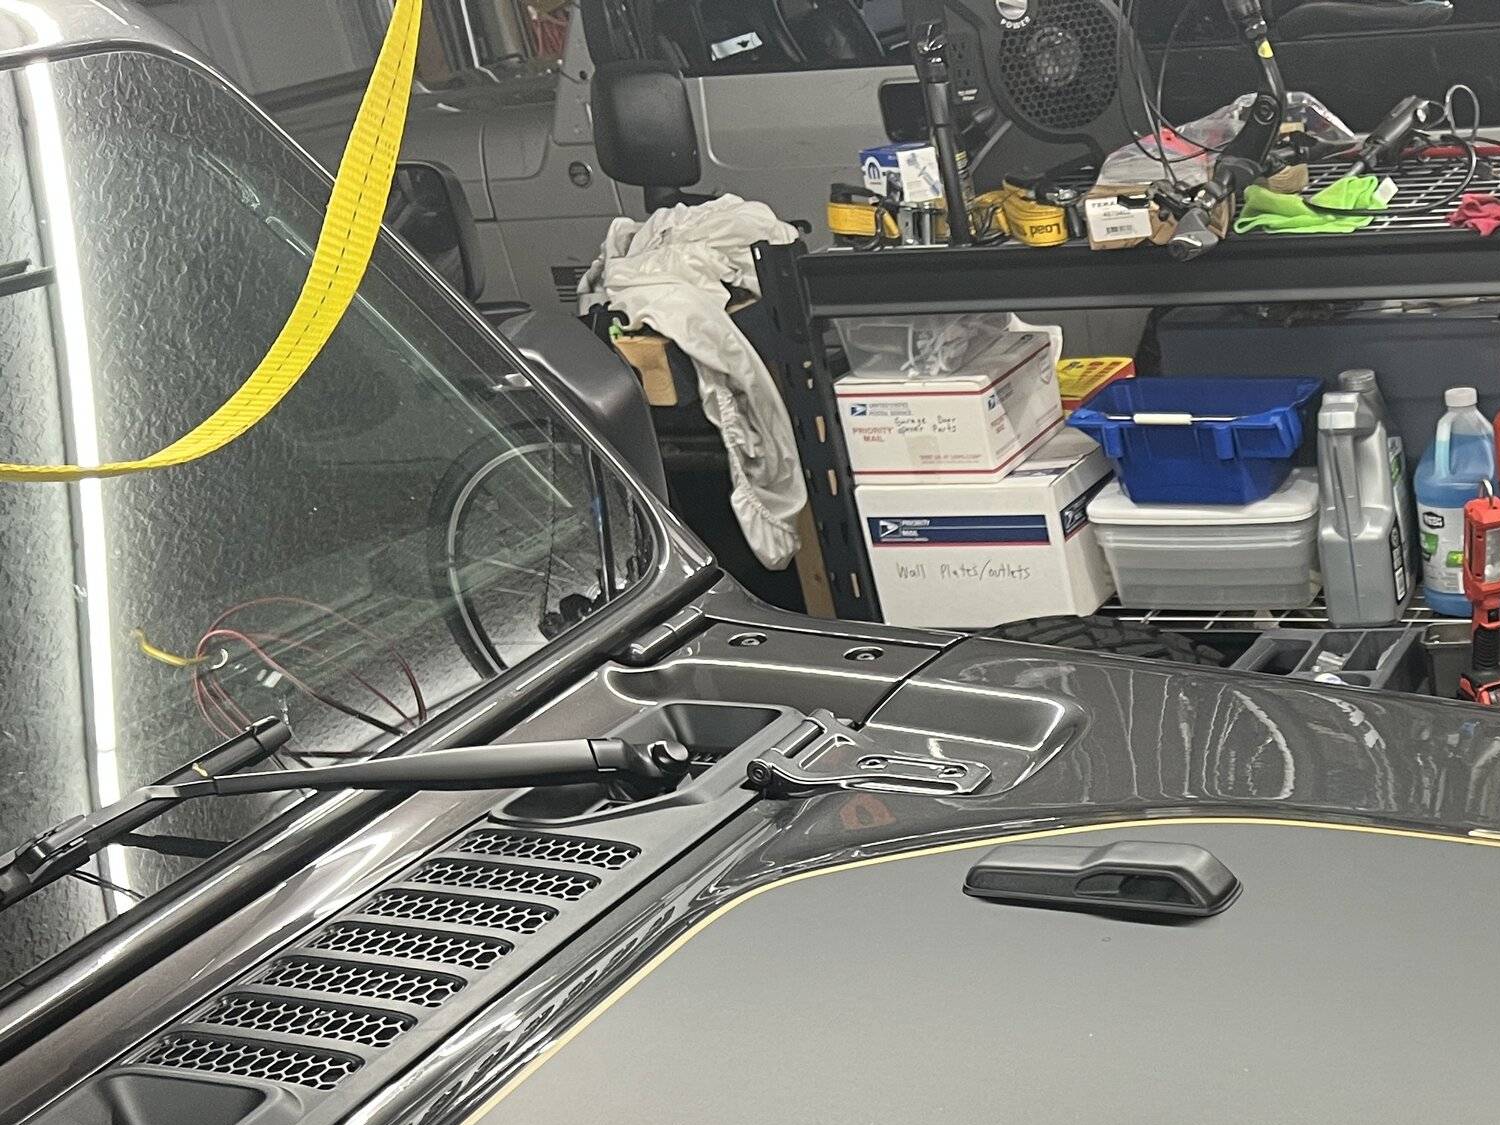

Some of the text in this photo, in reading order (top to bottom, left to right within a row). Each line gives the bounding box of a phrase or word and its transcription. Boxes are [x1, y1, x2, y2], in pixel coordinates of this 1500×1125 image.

[1029, 223, 1062, 238] Load
[852, 426, 894, 435] PRIORITY
[896, 562, 926, 579] Wall
